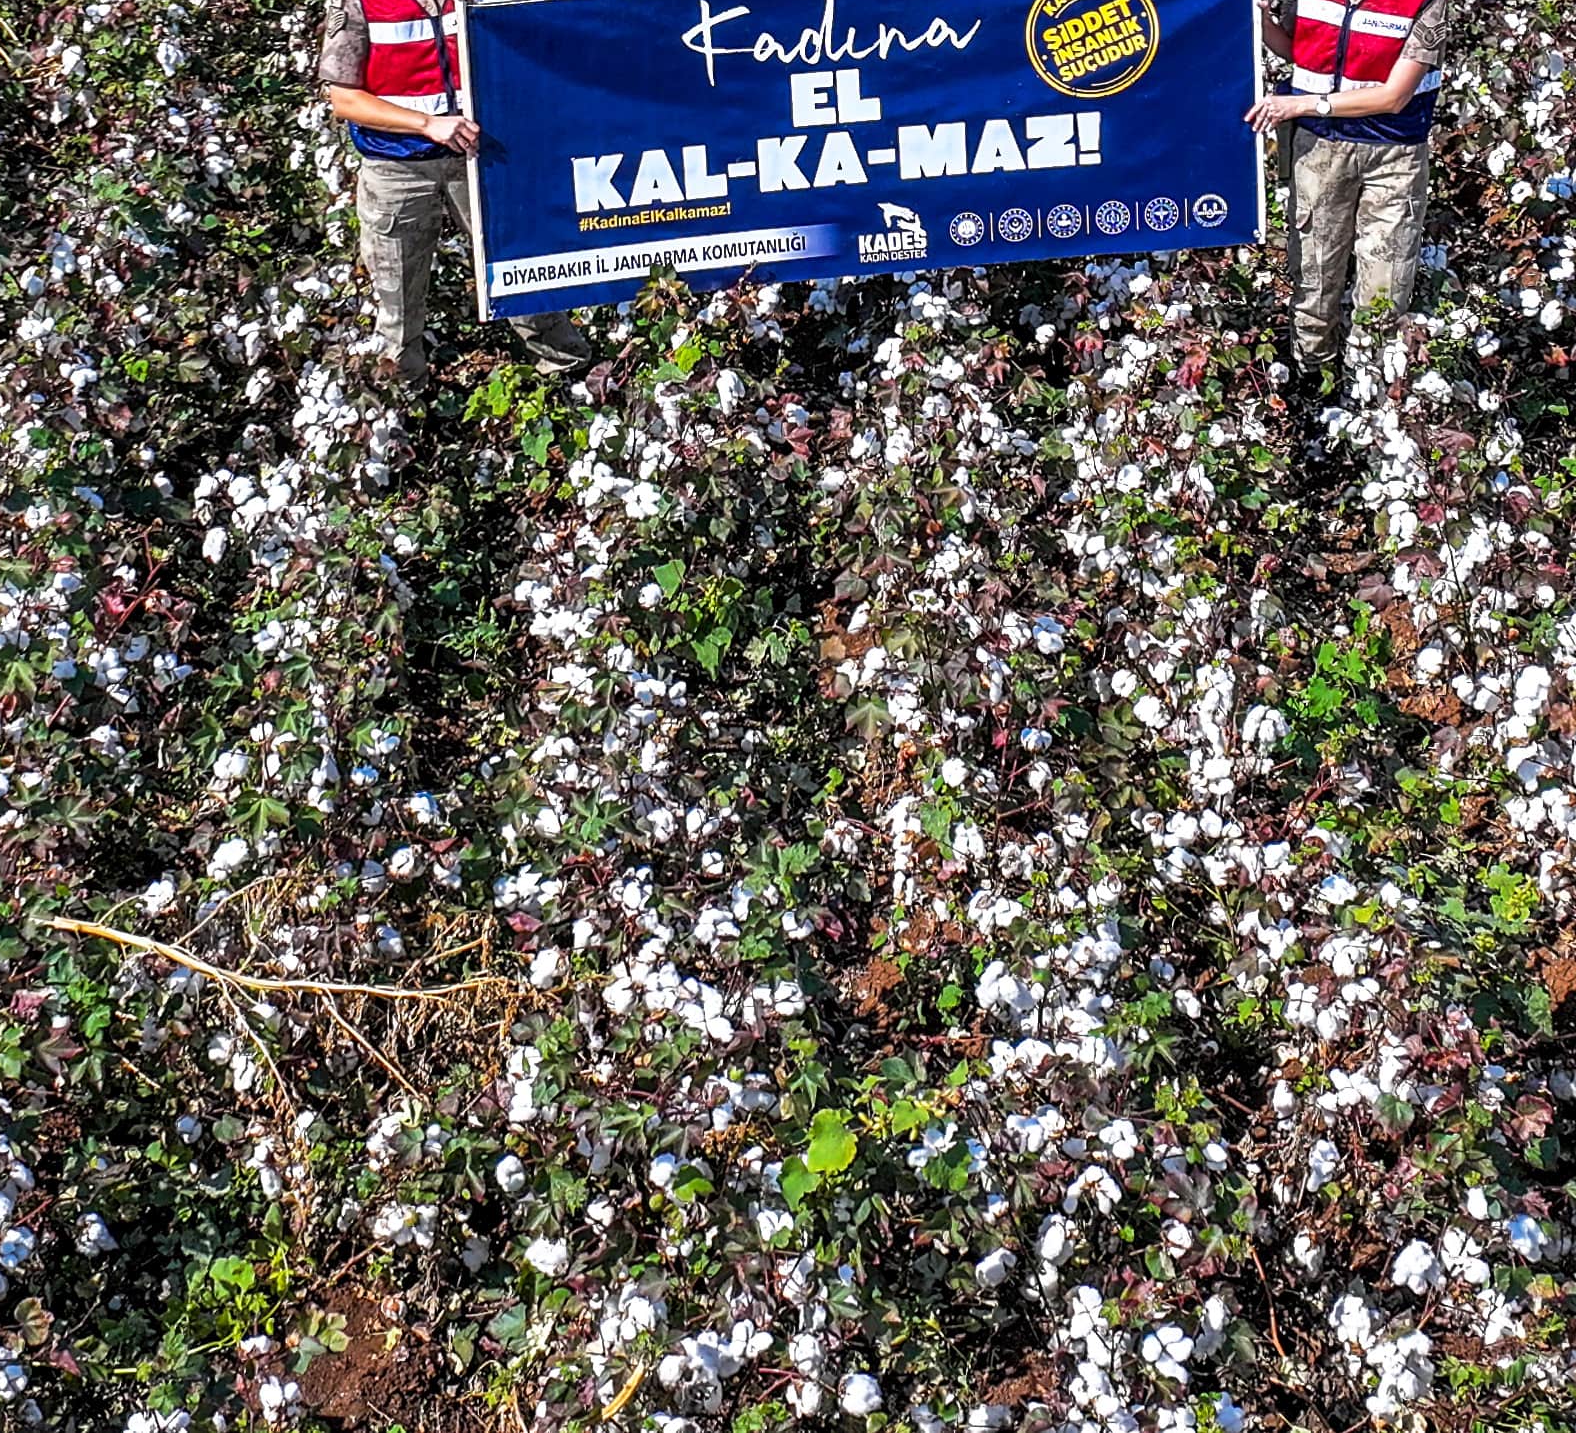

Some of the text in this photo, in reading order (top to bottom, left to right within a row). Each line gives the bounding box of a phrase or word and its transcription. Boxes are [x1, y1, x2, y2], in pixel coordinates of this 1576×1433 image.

[1058, 33, 1149, 82] SUÇUDUR
[790, 68, 882, 128] EL
[573, 111, 1103, 214] KAL-KA-MAZ!
[578, 201, 732, 232] #KadınaElKalkamaz!
[502, 231, 807, 287] DİYARBAKIR İL JANDARMA KOMUTANLIĞI
[858, 229, 928, 255] KADES
[891, 248, 928, 261] DESTEK
